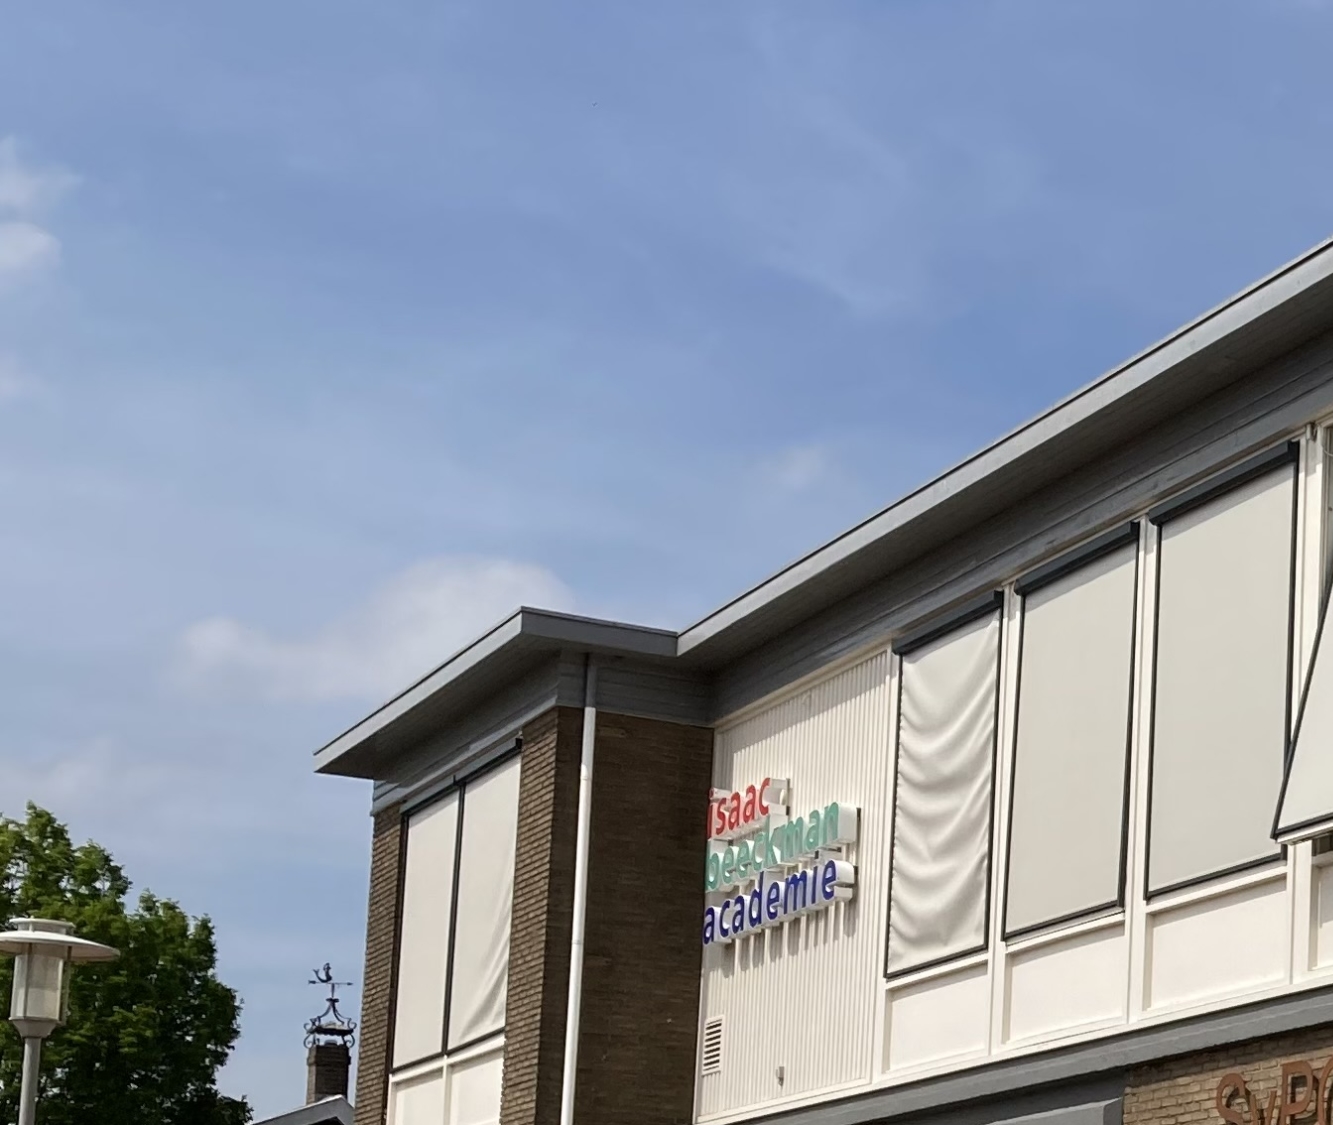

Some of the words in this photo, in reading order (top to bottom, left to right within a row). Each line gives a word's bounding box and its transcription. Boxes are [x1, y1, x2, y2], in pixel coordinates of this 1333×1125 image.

[704, 801, 840, 893] beeckman
[706, 777, 771, 839] isaac
[702, 859, 837, 945] academie
